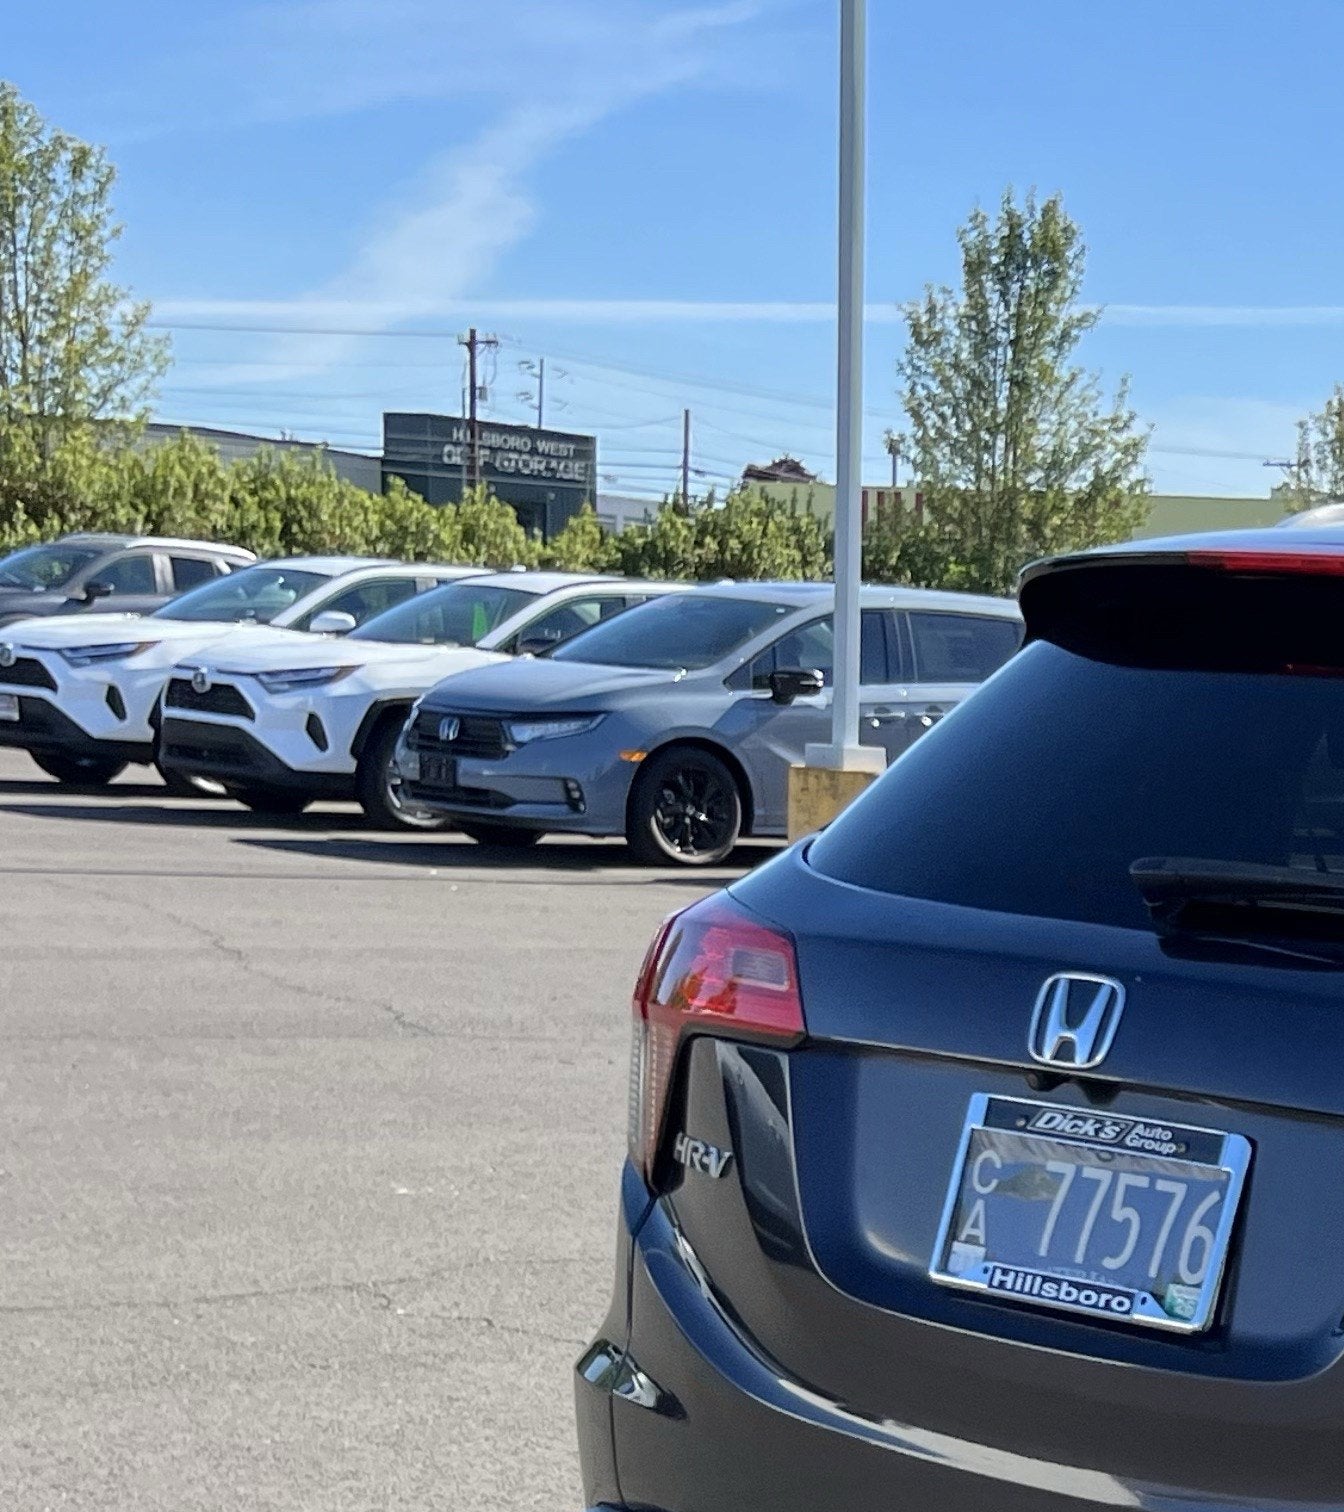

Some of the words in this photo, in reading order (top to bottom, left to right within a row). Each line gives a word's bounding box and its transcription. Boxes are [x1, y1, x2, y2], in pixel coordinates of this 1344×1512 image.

[452, 426, 532, 452] HISBORO
[1034, 1111, 1121, 1140] Dick's
[1134, 1122, 1173, 1141] Auto
[1124, 1132, 1177, 1155] Group
[1038, 1159, 1223, 1285] 77576
[991, 1267, 1132, 1312] Hillsboro
